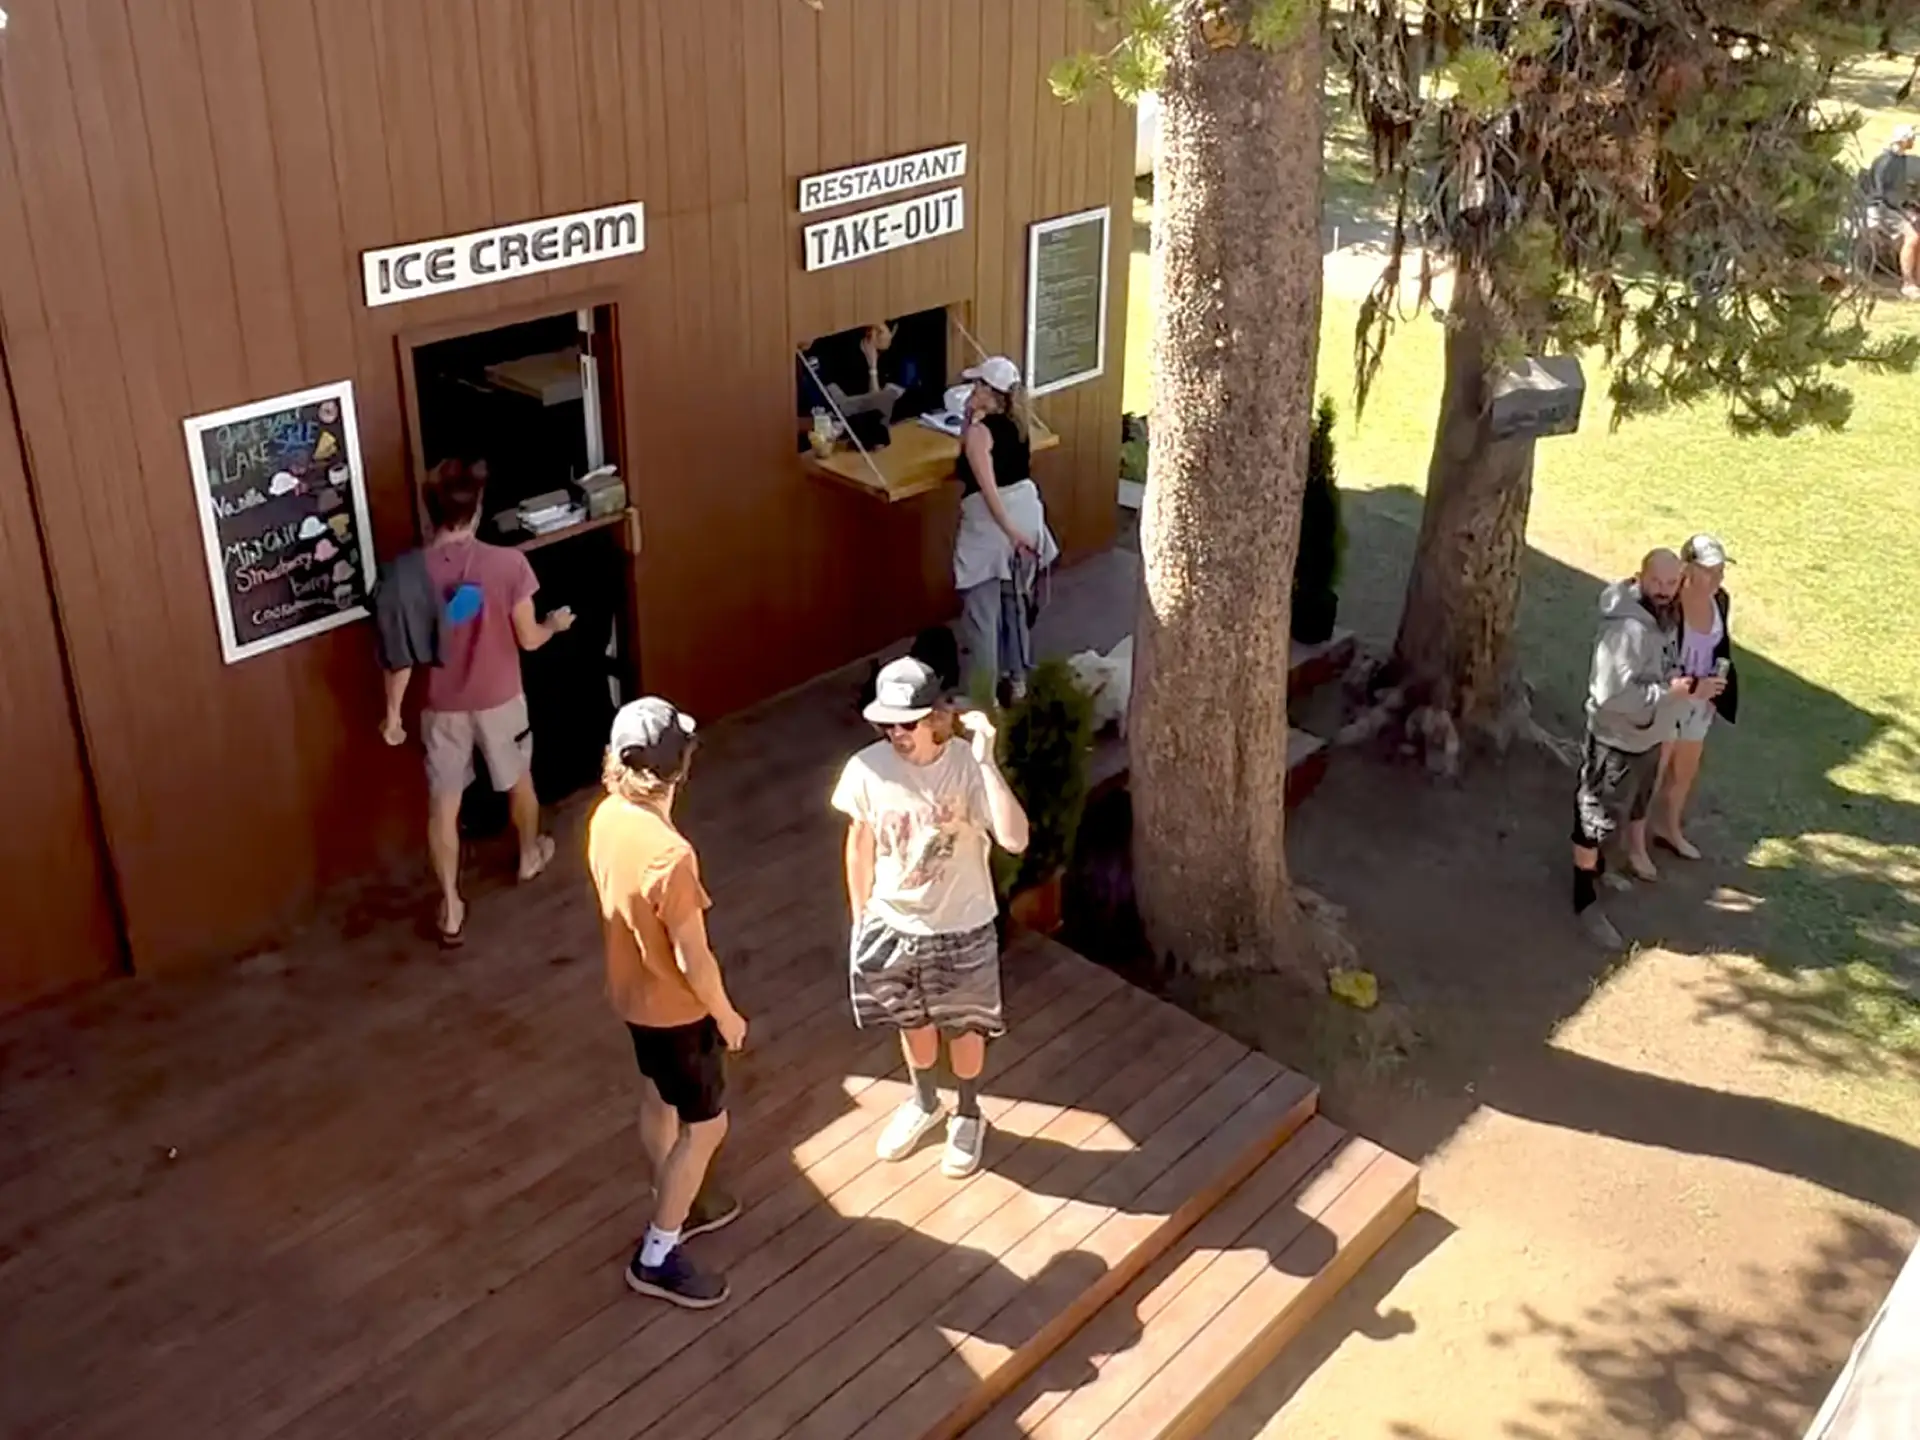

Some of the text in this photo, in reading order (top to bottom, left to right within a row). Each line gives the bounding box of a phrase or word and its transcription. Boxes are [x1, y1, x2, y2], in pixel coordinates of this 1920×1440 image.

[805, 150, 963, 207] RESTAURANT
[378, 211, 637, 294] ICE CREAM
[810, 194, 958, 264] TAKE-OUT
